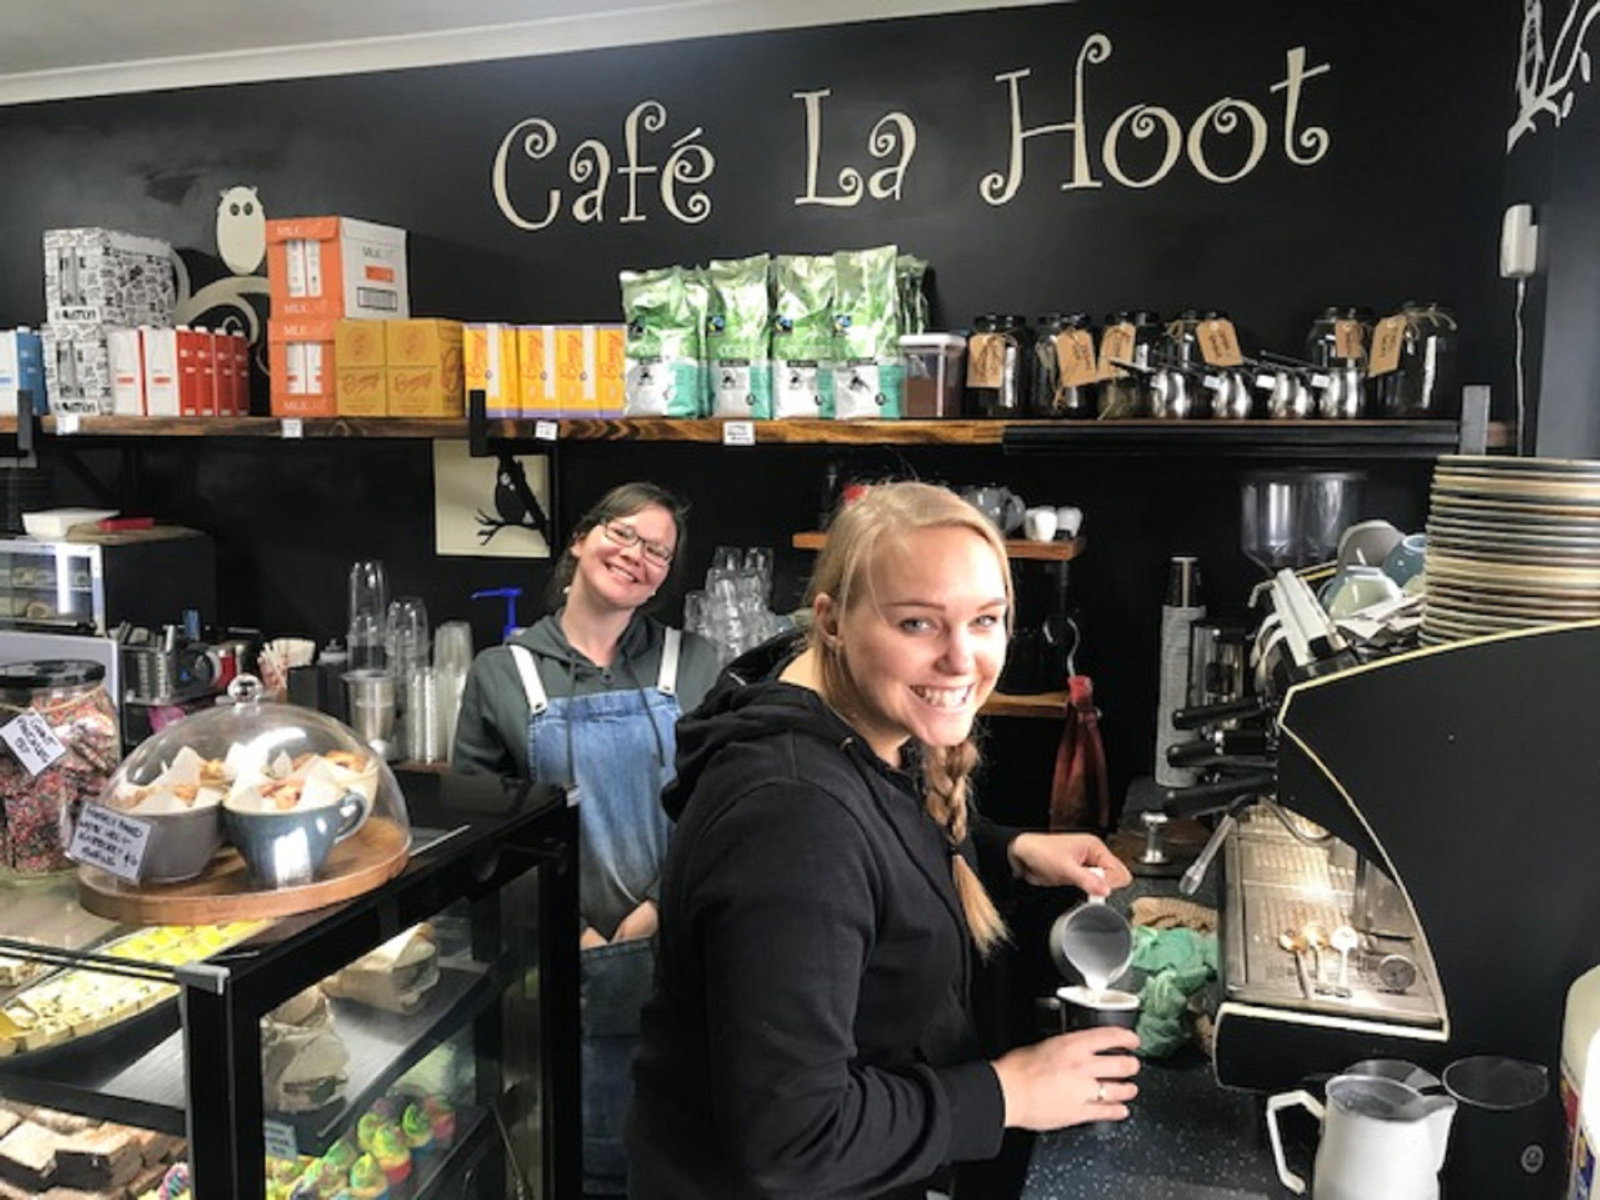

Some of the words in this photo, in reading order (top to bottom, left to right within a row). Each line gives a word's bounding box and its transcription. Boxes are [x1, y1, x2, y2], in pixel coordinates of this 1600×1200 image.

[492, 100, 715, 231] Café
[793, 88, 917, 207] La
[979, 33, 1331, 206] Hoot
